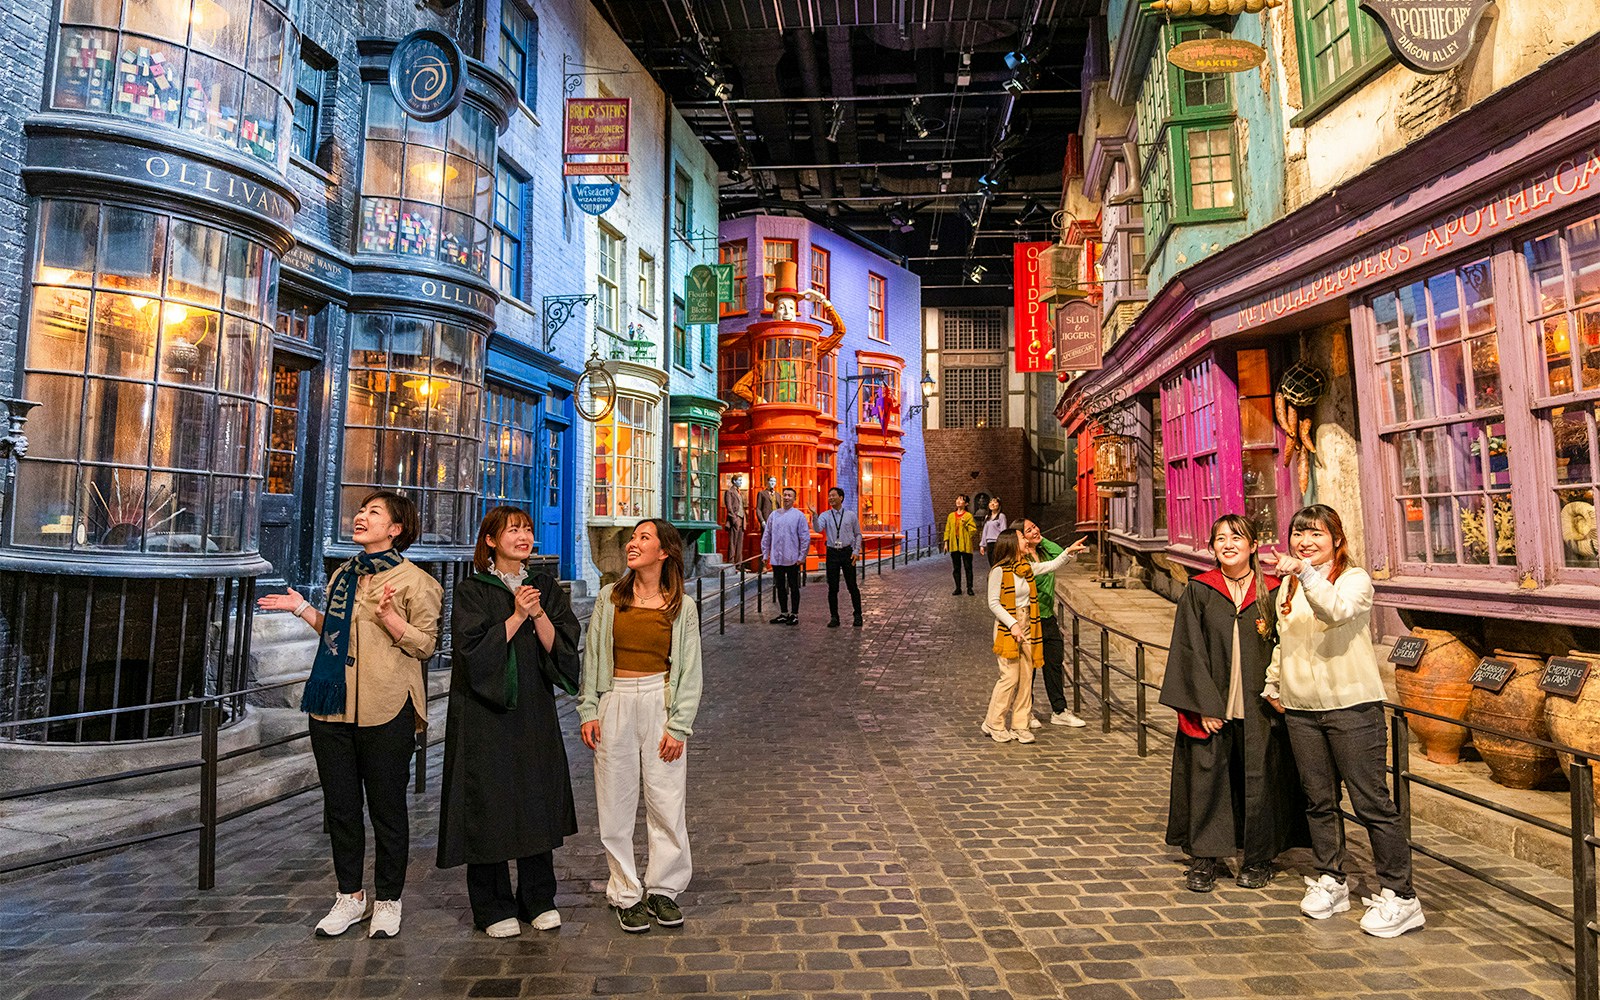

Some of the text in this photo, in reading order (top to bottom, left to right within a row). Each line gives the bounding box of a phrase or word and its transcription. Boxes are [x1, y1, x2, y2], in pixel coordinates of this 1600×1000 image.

[1390, 7, 1471, 40] APOTHECARY
[1398, 35, 1459, 62] DIAGON ALLEY
[569, 105, 595, 119] BREWS
[600, 104, 627, 119] STEWS
[571, 125, 624, 134] FISHY DINNERS
[299, 251, 342, 274] FINE WANDS
[1027, 247, 1044, 369] QUIDDITCH
[1066, 315, 1089, 324] SLUG
[1061, 332, 1096, 342] JIGGERS
[1393, 648, 1418, 658] SPLEEN
